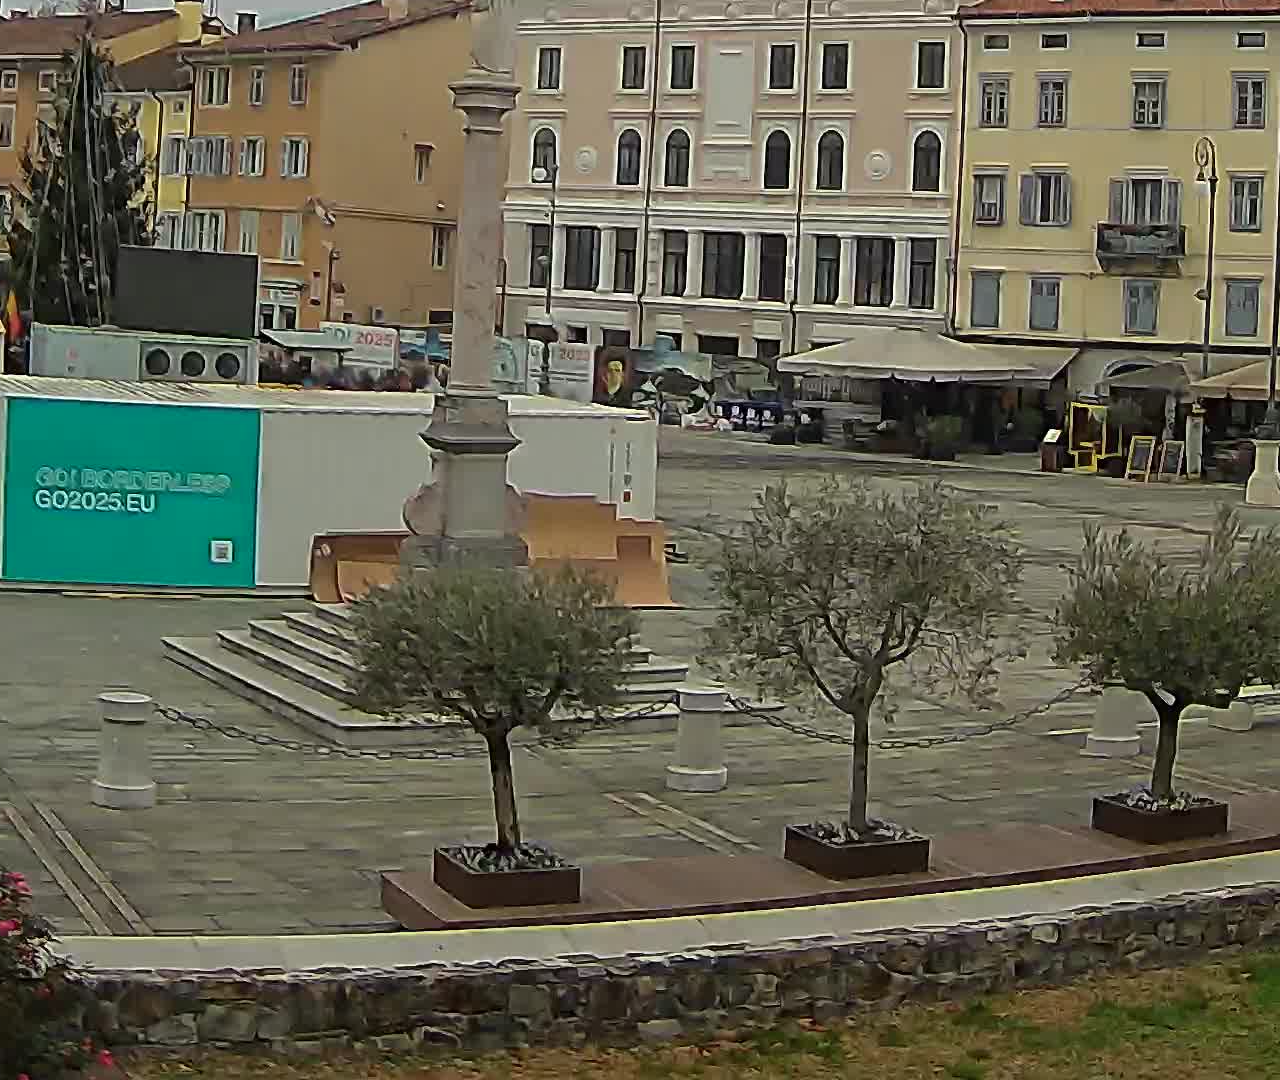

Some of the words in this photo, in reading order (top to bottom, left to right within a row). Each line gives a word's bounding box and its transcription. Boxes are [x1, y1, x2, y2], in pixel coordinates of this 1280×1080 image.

[356, 330, 393, 346] 2025
[35, 466, 77, 488] GO!
[80, 468, 232, 495] BORDERLESS
[35, 489, 156, 513] GO2025.EU
